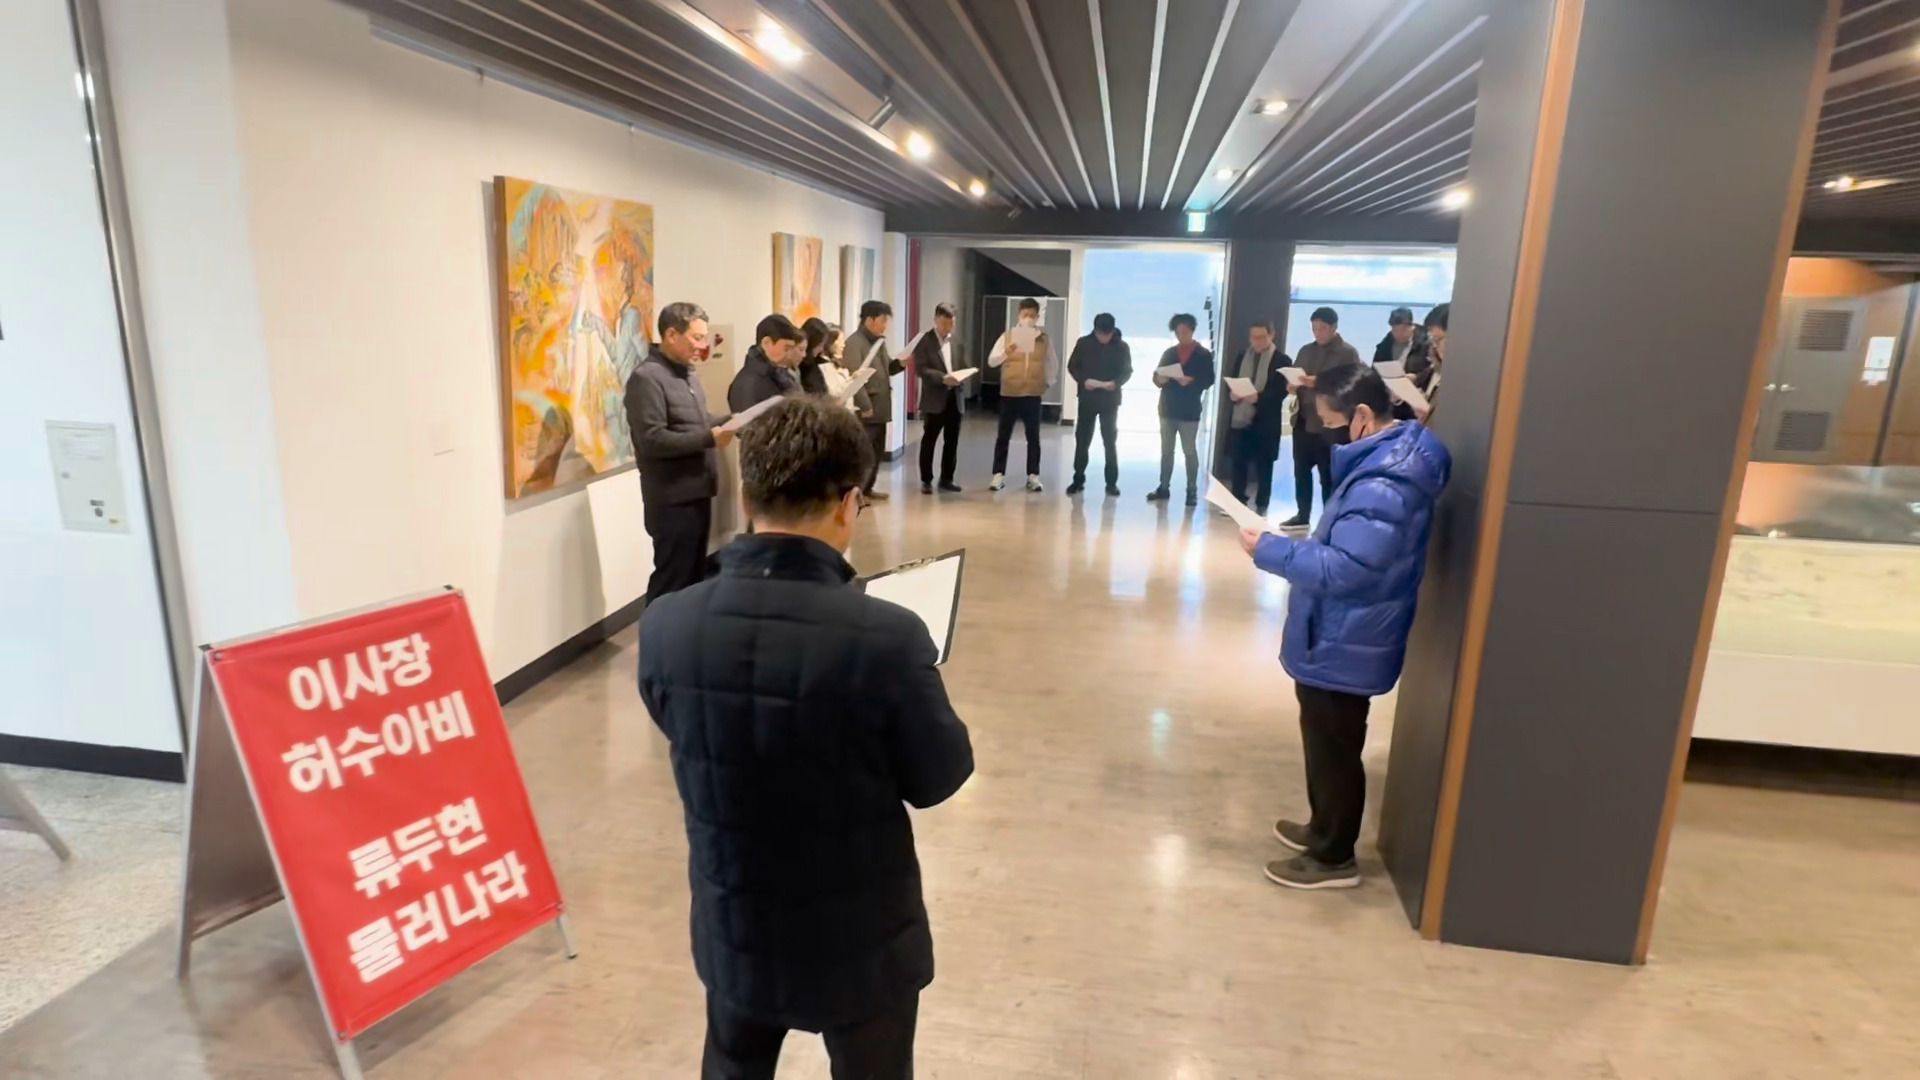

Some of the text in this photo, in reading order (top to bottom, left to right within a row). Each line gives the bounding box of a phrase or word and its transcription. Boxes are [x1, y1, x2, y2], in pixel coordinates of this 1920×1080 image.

[289, 633, 432, 711] 이사장
[282, 691, 475, 793] 허수아비
[349, 797, 488, 898] 류두현
[348, 851, 529, 983] 물러나라
